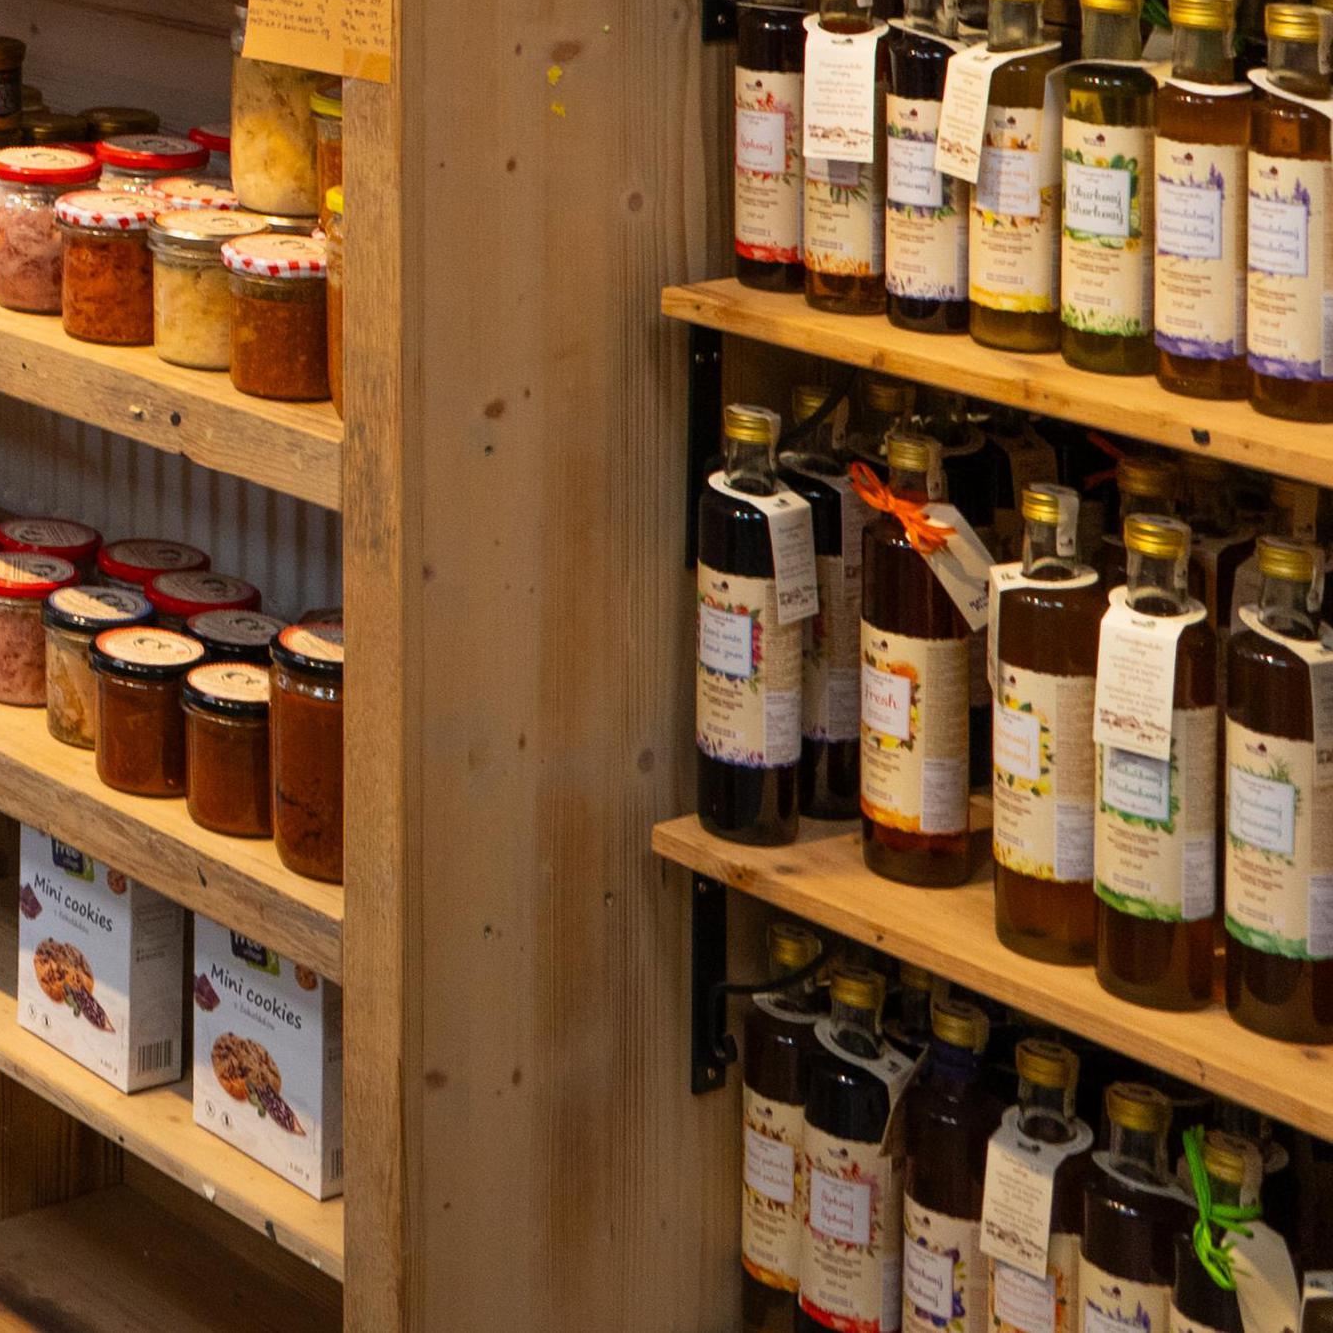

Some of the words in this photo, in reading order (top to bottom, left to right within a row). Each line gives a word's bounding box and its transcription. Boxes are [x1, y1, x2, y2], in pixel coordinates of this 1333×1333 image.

[33, 872, 62, 905] Mini
[66, 894, 115, 934] cookies
[210, 962, 243, 998] Mini
[246, 989, 304, 1031] cookies
